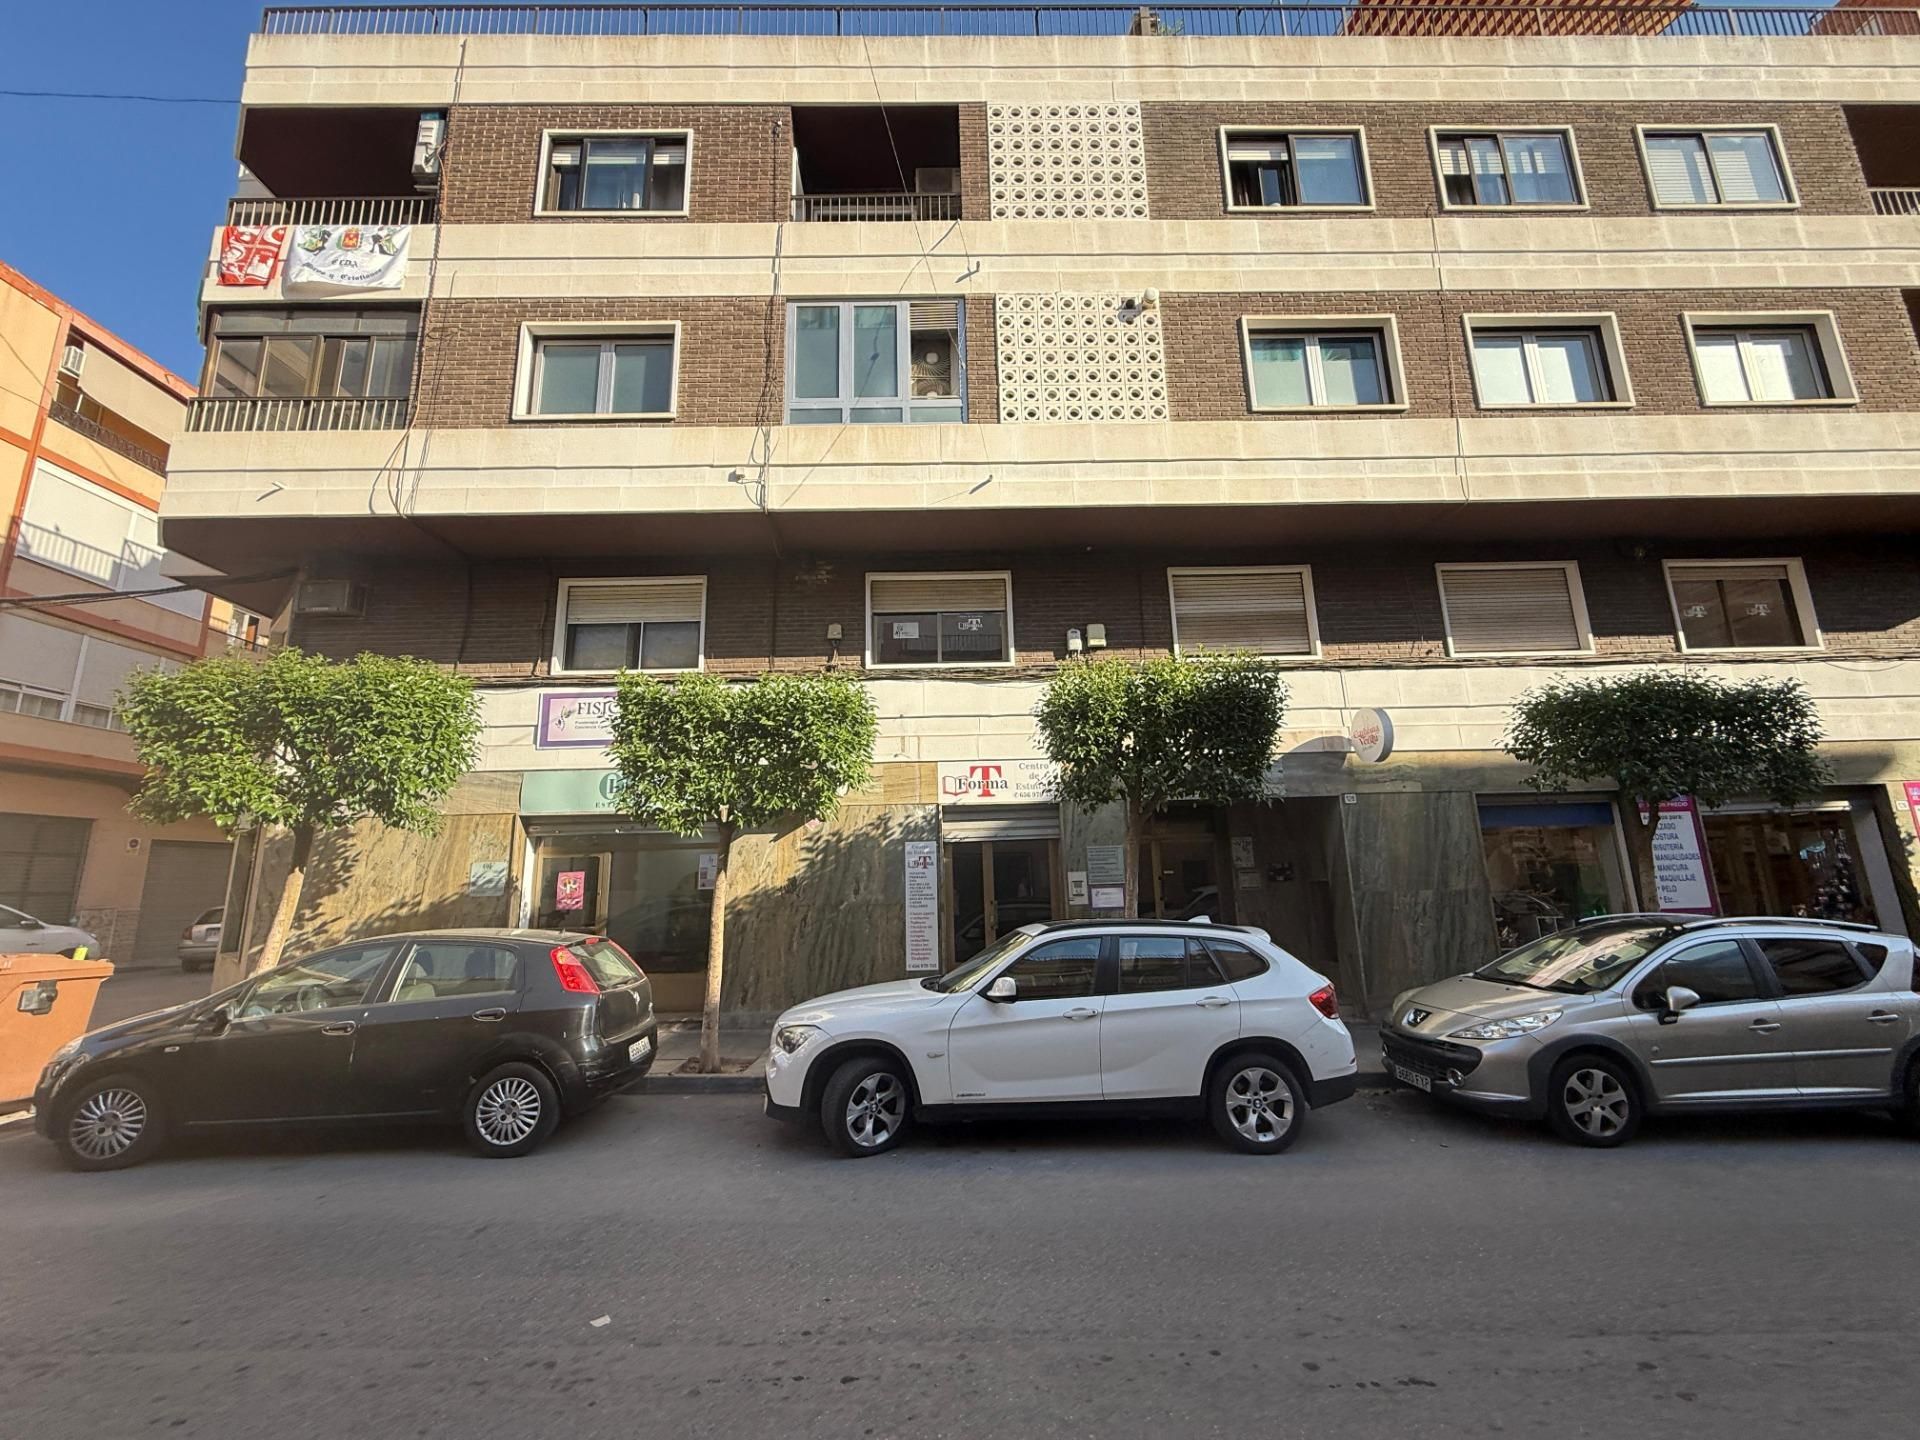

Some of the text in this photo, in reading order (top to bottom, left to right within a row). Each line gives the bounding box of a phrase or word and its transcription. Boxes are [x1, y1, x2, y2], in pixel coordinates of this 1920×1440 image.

[1018, 762, 1049, 770] Centro
[1029, 771, 1040, 780] de
[957, 778, 1009, 790] Forma
[1654, 833, 1680, 841] OSTURA
[1657, 863, 1689, 872] MANICURA
[1659, 873, 1697, 882] MAQUILLAJE
[1661, 884, 1678, 893] PELO
